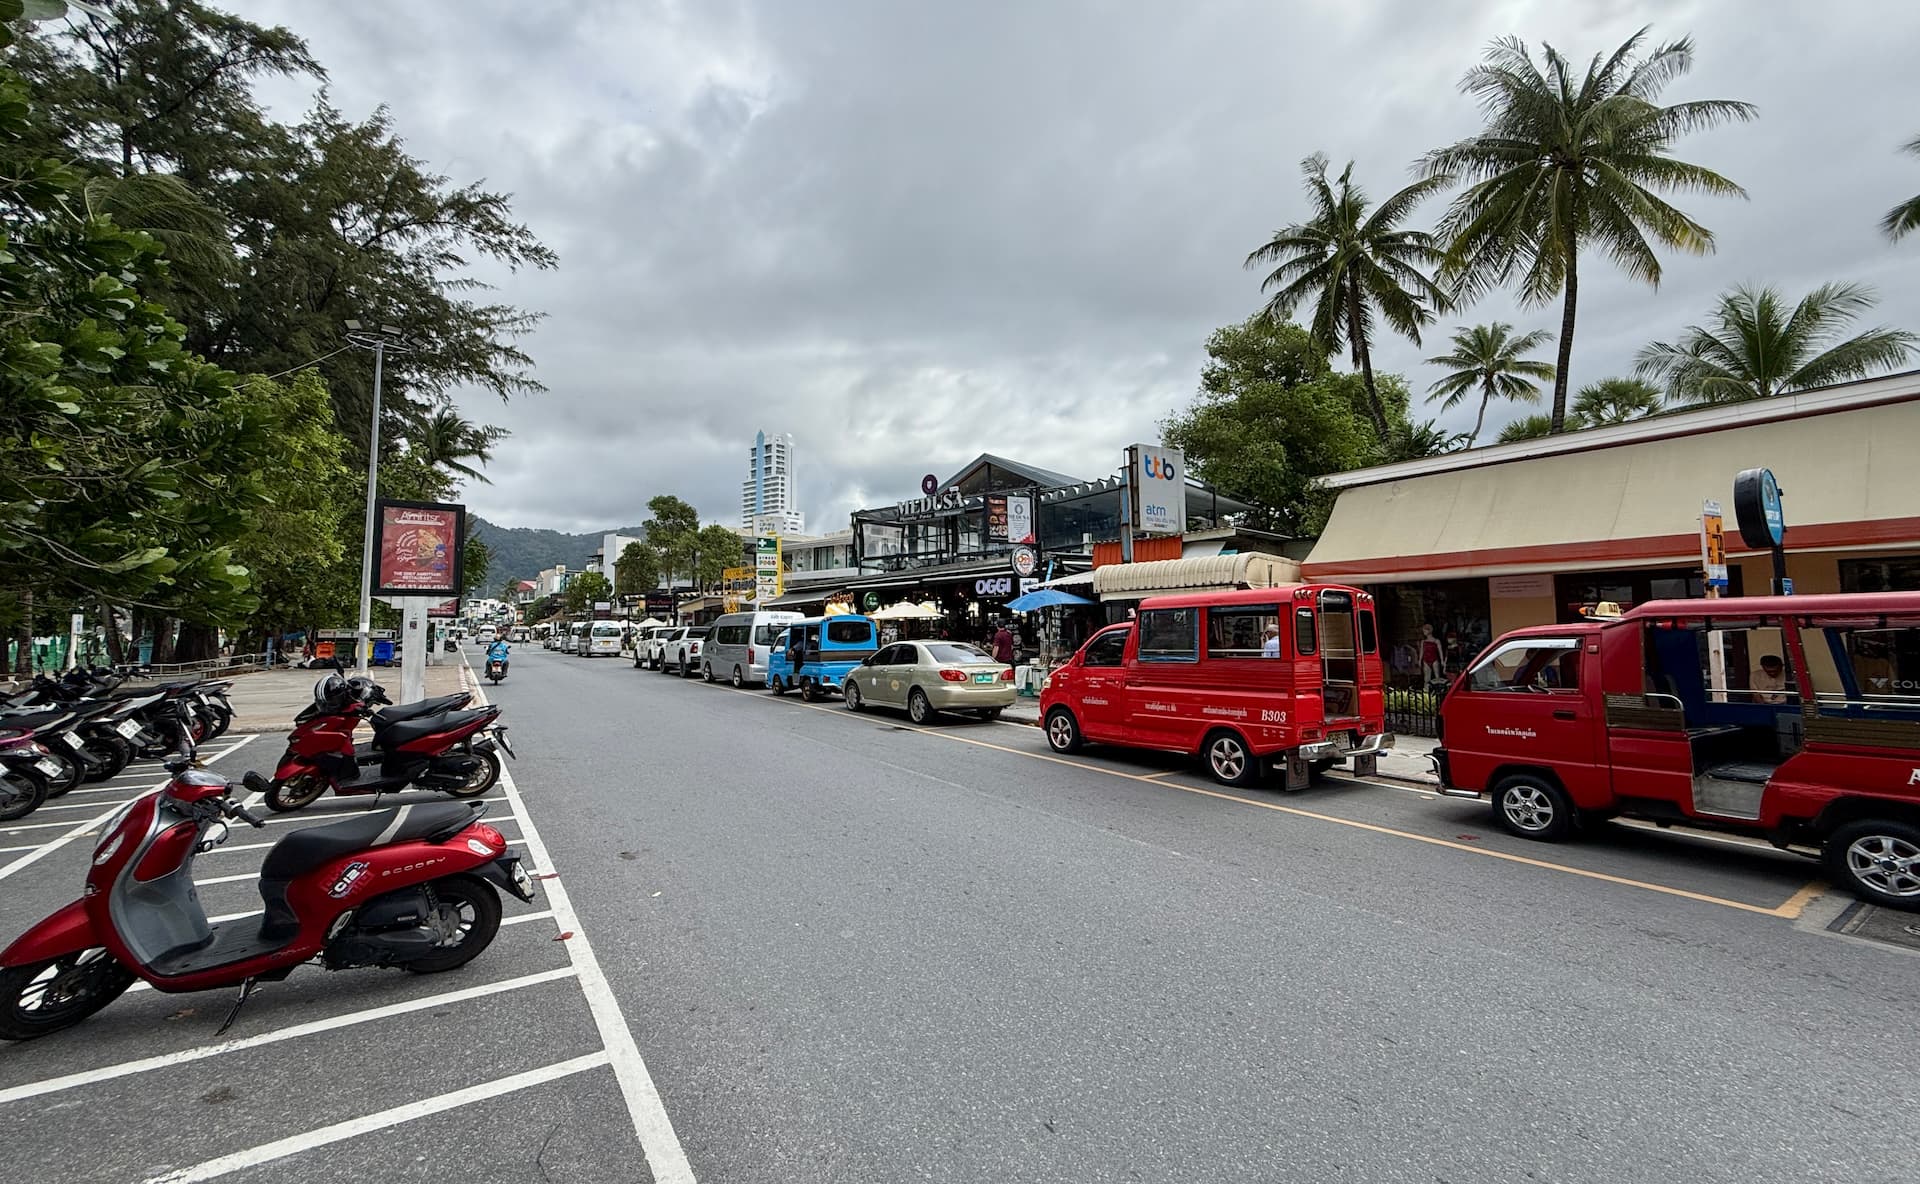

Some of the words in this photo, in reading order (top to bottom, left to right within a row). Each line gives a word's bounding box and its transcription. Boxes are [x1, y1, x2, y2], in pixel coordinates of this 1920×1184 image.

[1144, 454, 1175, 480] ttb
[897, 491, 964, 515] MEDUSA
[1145, 504, 1166, 516] atm
[975, 578, 1011, 594] OGGI
[1261, 709, 1287, 722] B303
